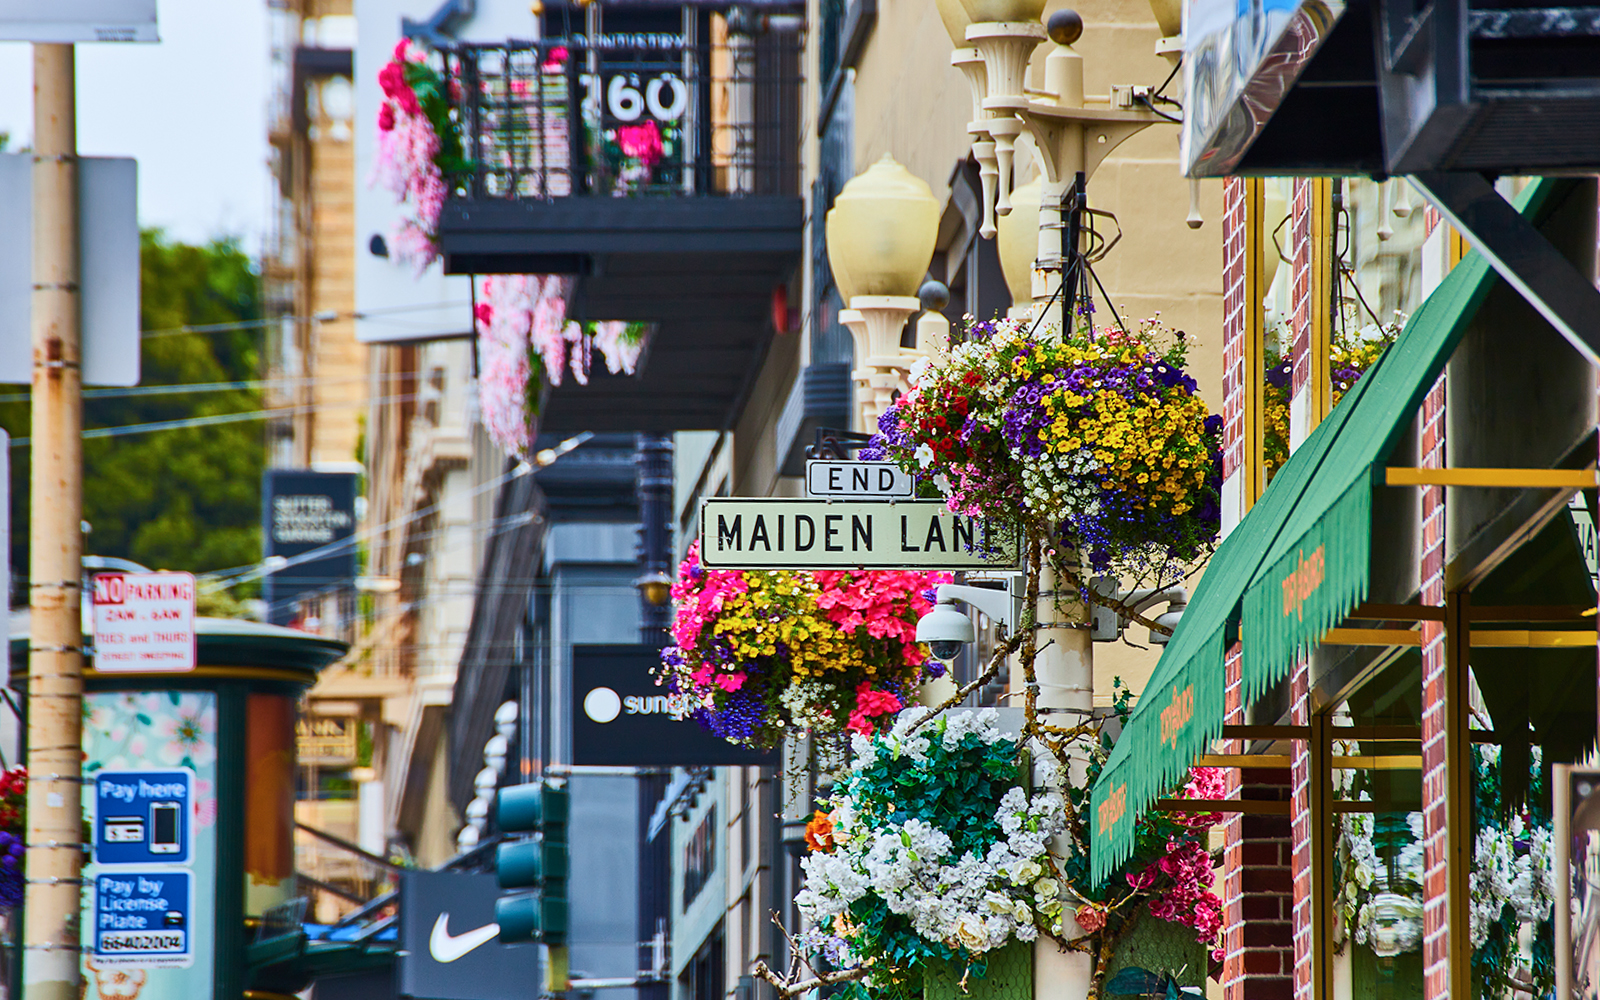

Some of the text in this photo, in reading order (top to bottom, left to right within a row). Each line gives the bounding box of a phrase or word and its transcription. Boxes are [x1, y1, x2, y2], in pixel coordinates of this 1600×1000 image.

[828, 467, 895, 491] END
[717, 514, 873, 552] MAIDEN
[95, 577, 192, 603] NO PARKING
[100, 778, 186, 804] Pay here
[100, 876, 164, 898] Pay by
[100, 895, 169, 912] License
[99, 912, 148, 929] Plate
